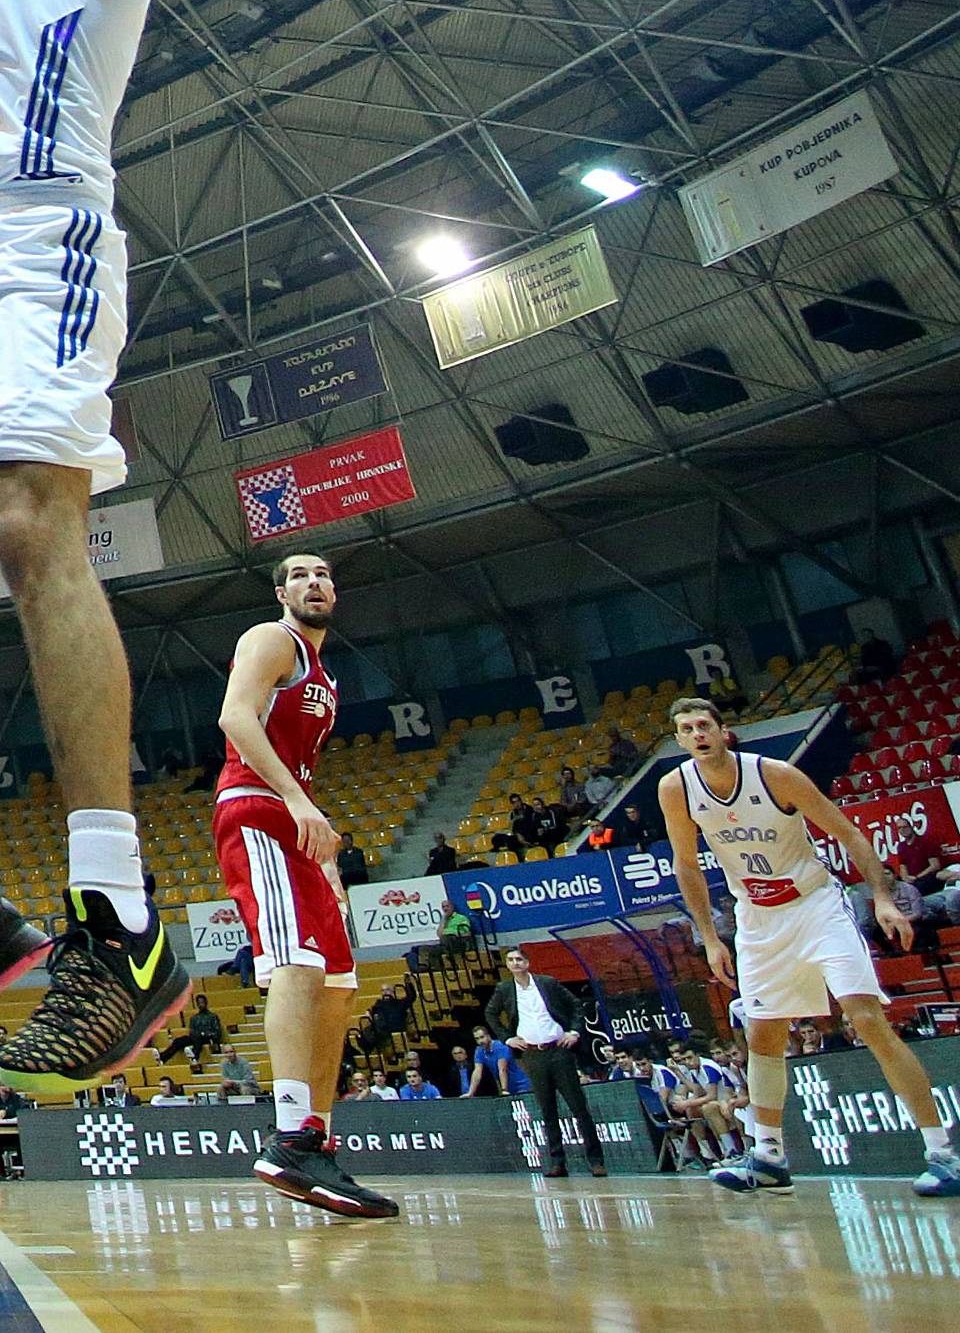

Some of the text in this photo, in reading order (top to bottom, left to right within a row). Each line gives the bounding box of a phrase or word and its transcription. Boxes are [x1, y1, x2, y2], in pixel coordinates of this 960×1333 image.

[759, 112, 863, 174] KUP POBJEDNIKA
[793, 149, 842, 181] KUPOVA
[311, 361, 334, 375] KUP
[330, 450, 366, 469] PRVAK
[299, 459, 404, 497] REPUBLIKE HRVATSKE
[341, 491, 370, 507] 2000
[536, 675, 578, 714] E
[388, 701, 431, 739] R
[740, 851, 773, 876] 20
[502, 874, 603, 907] QuoVadis
[363, 903, 441, 934] Zagreb
[611, 1008, 650, 1040] galić
[391, 1131, 445, 1151] MEN
